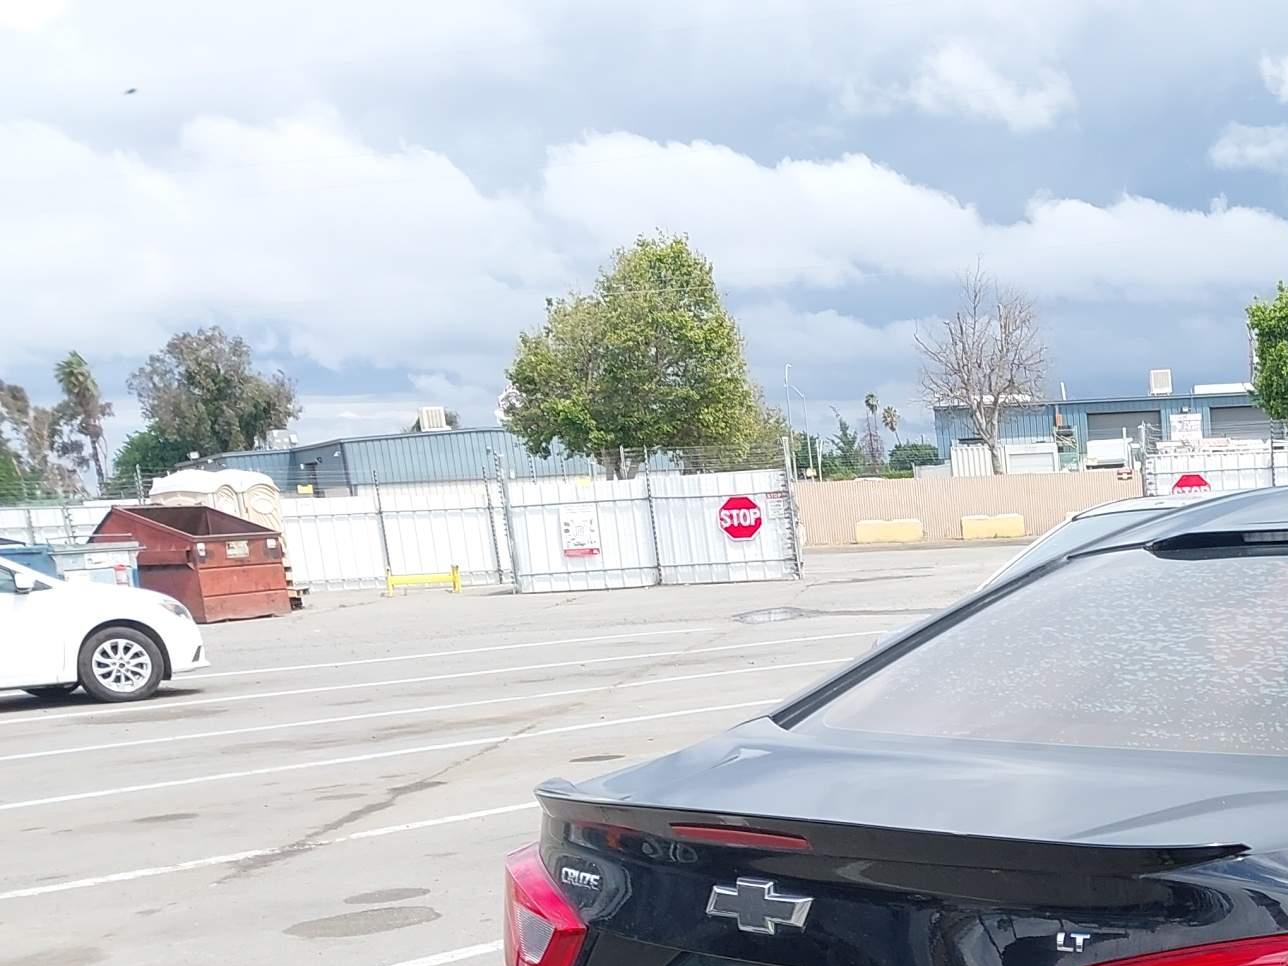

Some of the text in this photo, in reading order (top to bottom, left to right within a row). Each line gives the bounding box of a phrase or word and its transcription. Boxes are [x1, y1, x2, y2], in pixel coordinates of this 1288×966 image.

[720, 506, 761, 529] STOP
[561, 867, 600, 891] CRUZE
[1056, 932, 1091, 953] LT
